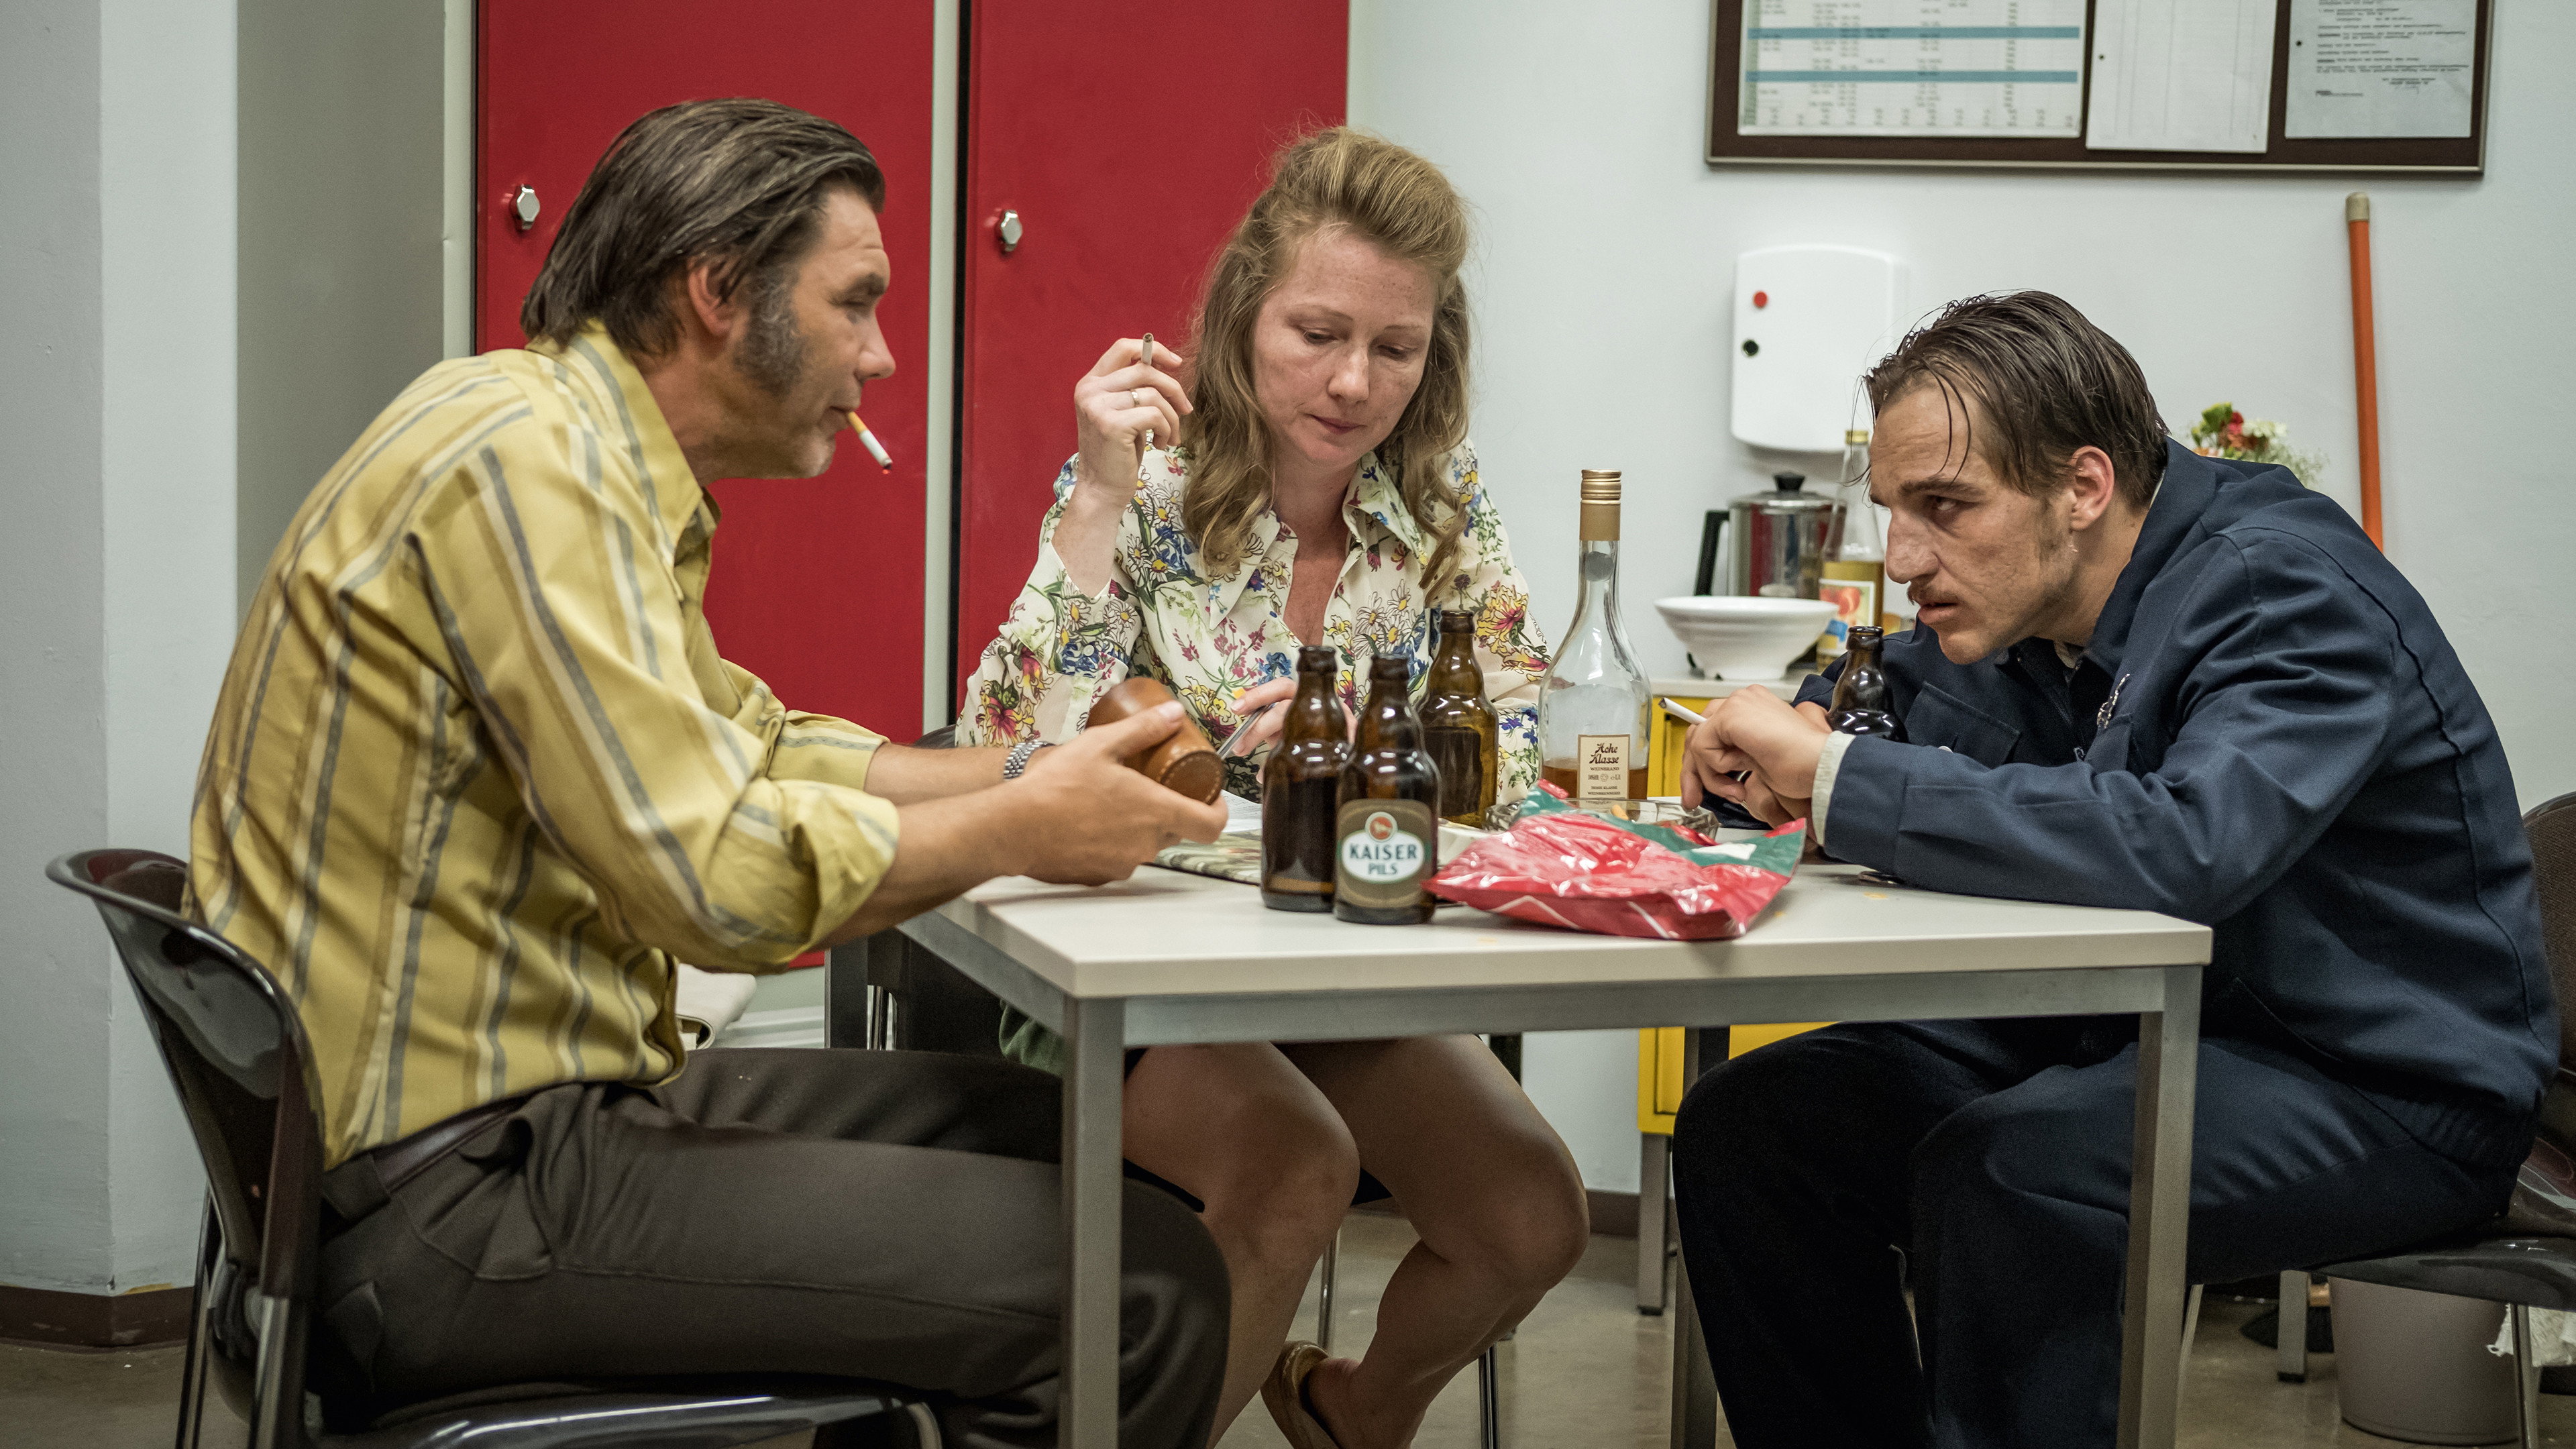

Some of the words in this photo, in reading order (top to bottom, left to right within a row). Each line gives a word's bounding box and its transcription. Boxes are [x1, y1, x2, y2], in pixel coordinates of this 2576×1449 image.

[1589, 753, 1619, 764] Klasse
[1350, 843, 1417, 860] KAISER
[1368, 863, 1399, 875] PILS
